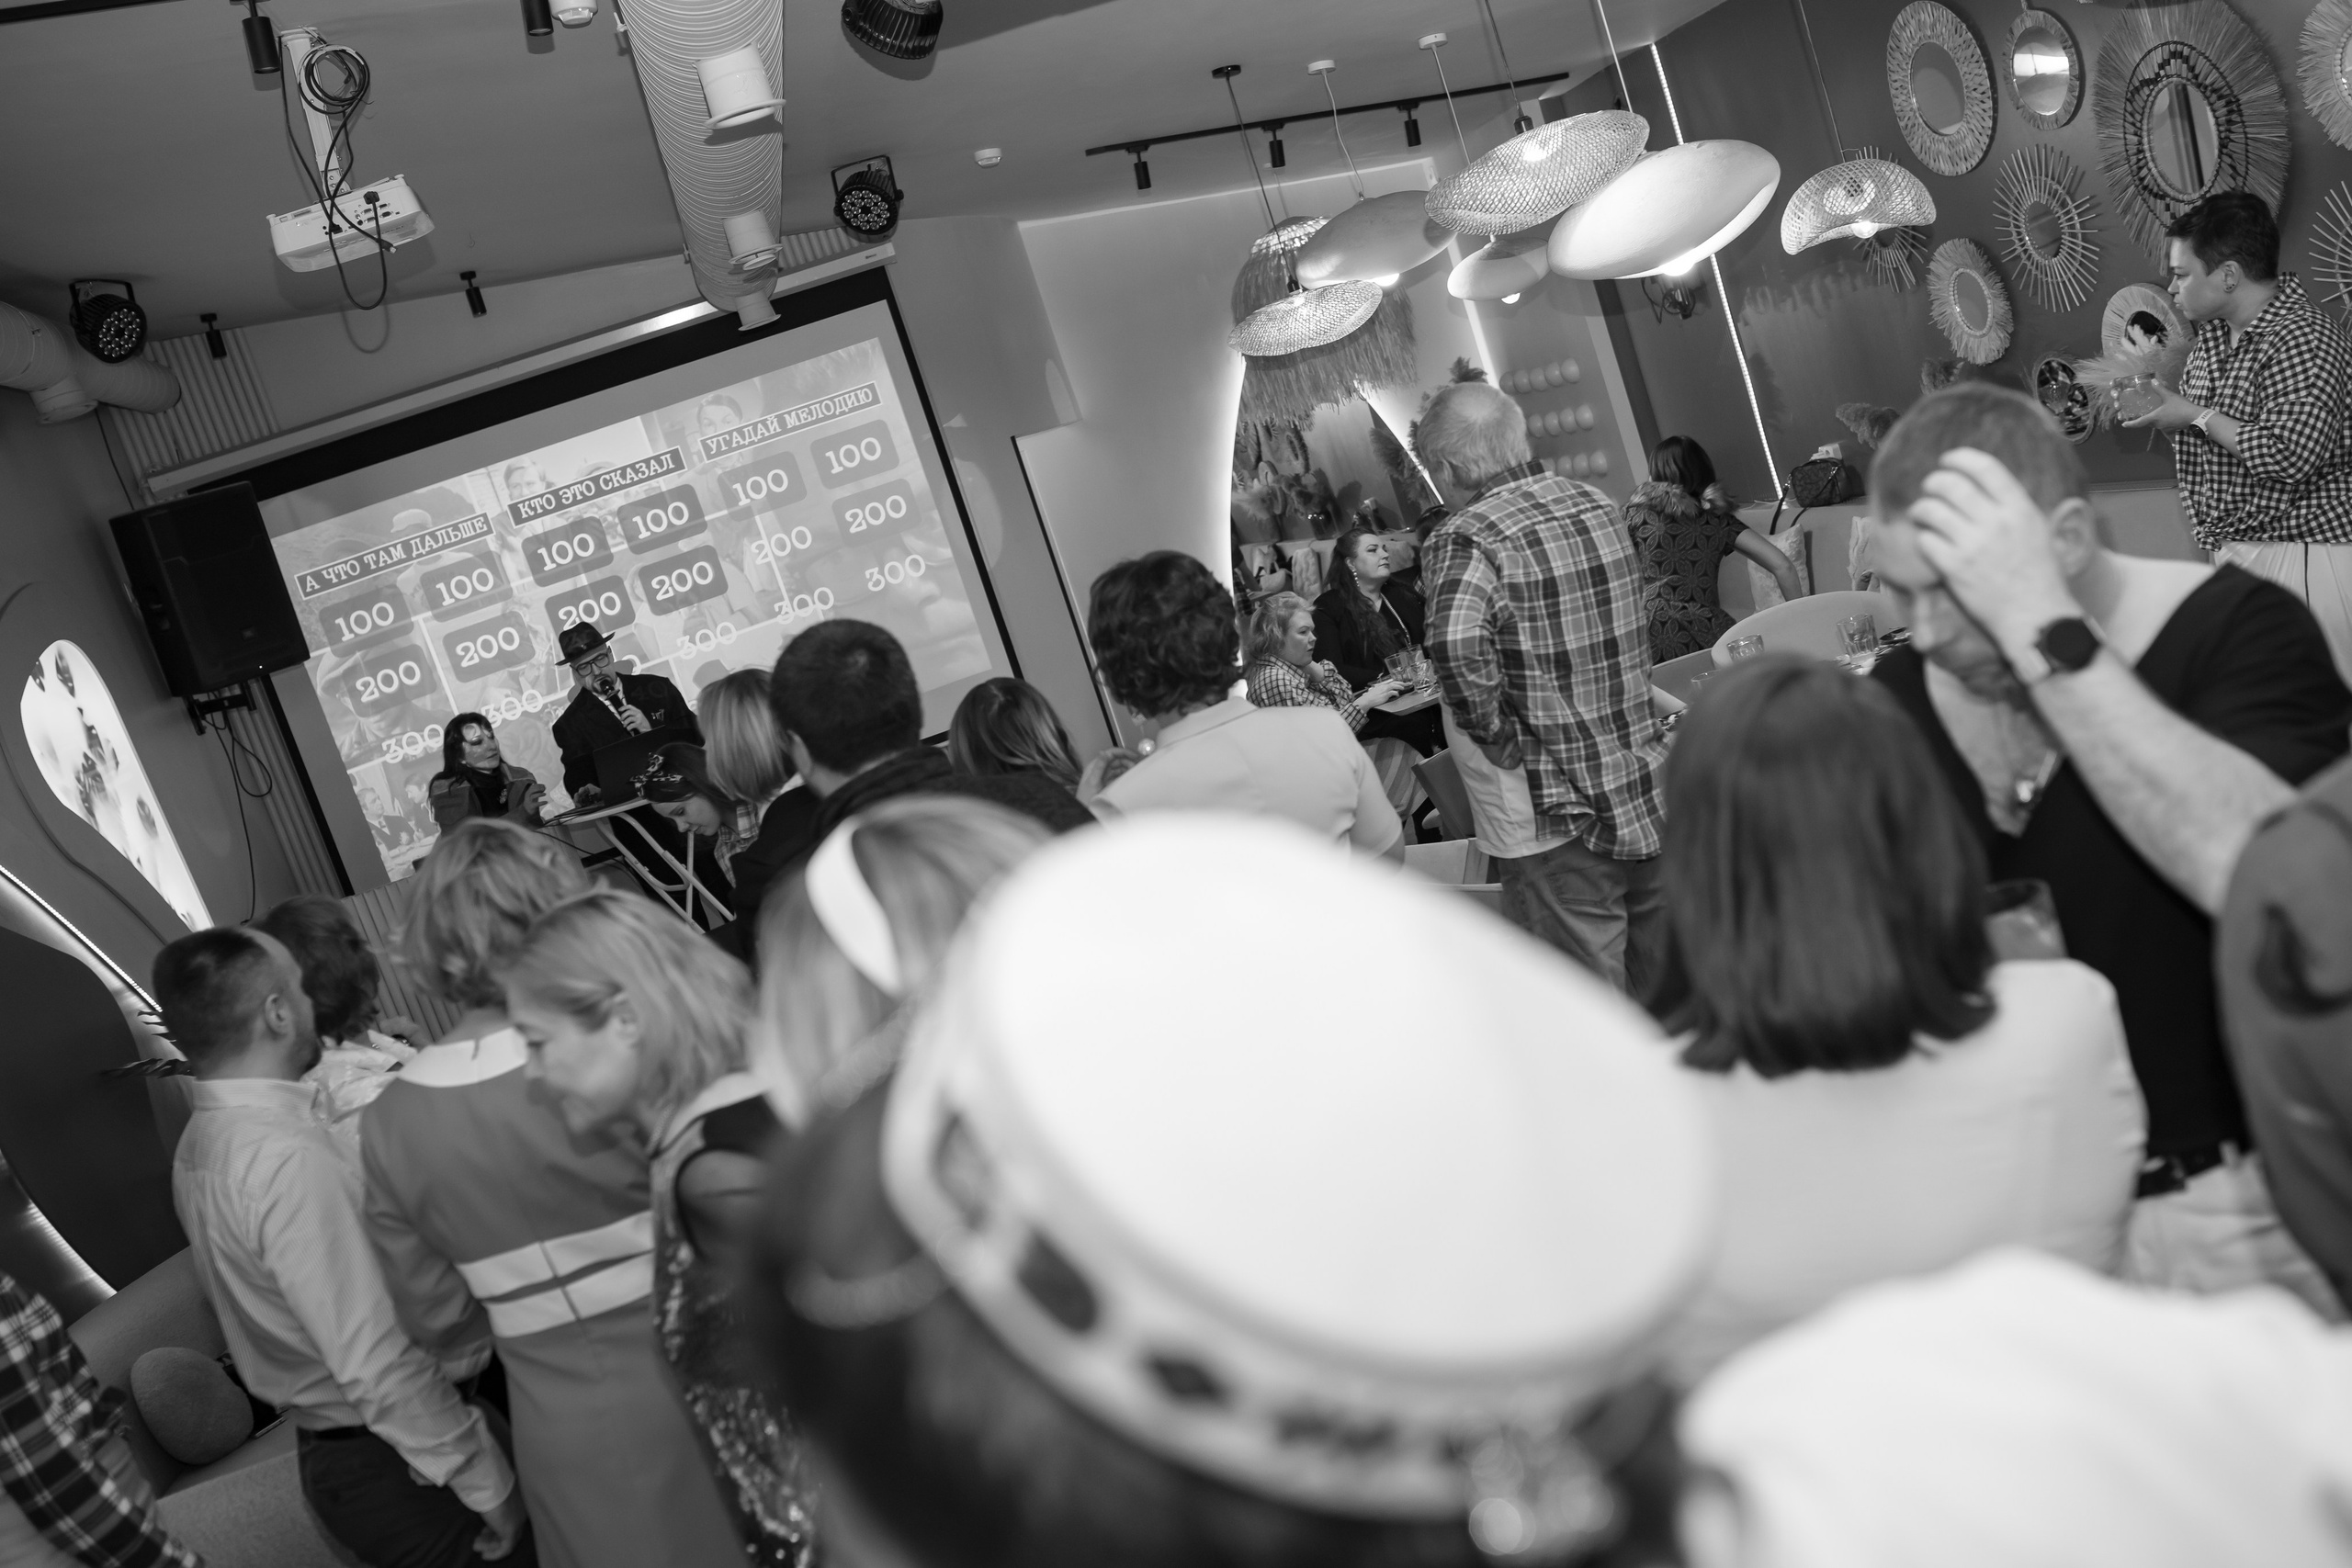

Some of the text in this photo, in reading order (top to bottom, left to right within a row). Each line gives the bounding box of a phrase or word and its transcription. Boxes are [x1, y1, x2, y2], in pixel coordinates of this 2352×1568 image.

[706, 388, 873, 455] УГАДАЙ МЕЛОДИЮ
[825, 436, 882, 475] 100
[517, 453, 675, 520] КТО ЭТО СКАЗАЛ
[732, 468, 789, 507] 100
[632, 502, 689, 540] 100
[844, 494, 908, 535] 200
[305, 516, 488, 592] А ЧТО ТАМ ДАЛЬШЕ
[537, 533, 595, 571] 100
[751, 525, 813, 566] 200
[435, 568, 494, 607] 100
[650, 561, 714, 601] 200
[865, 554, 926, 592] 300
[334, 602, 395, 642] 100
[558, 591, 622, 631] 200
[774, 586, 835, 626] 300
[455, 626, 520, 669] 200
[676, 621, 737, 660] 300
[356, 660, 422, 704] 200
[481, 689, 544, 729] 300
[381, 723, 445, 764] 300
